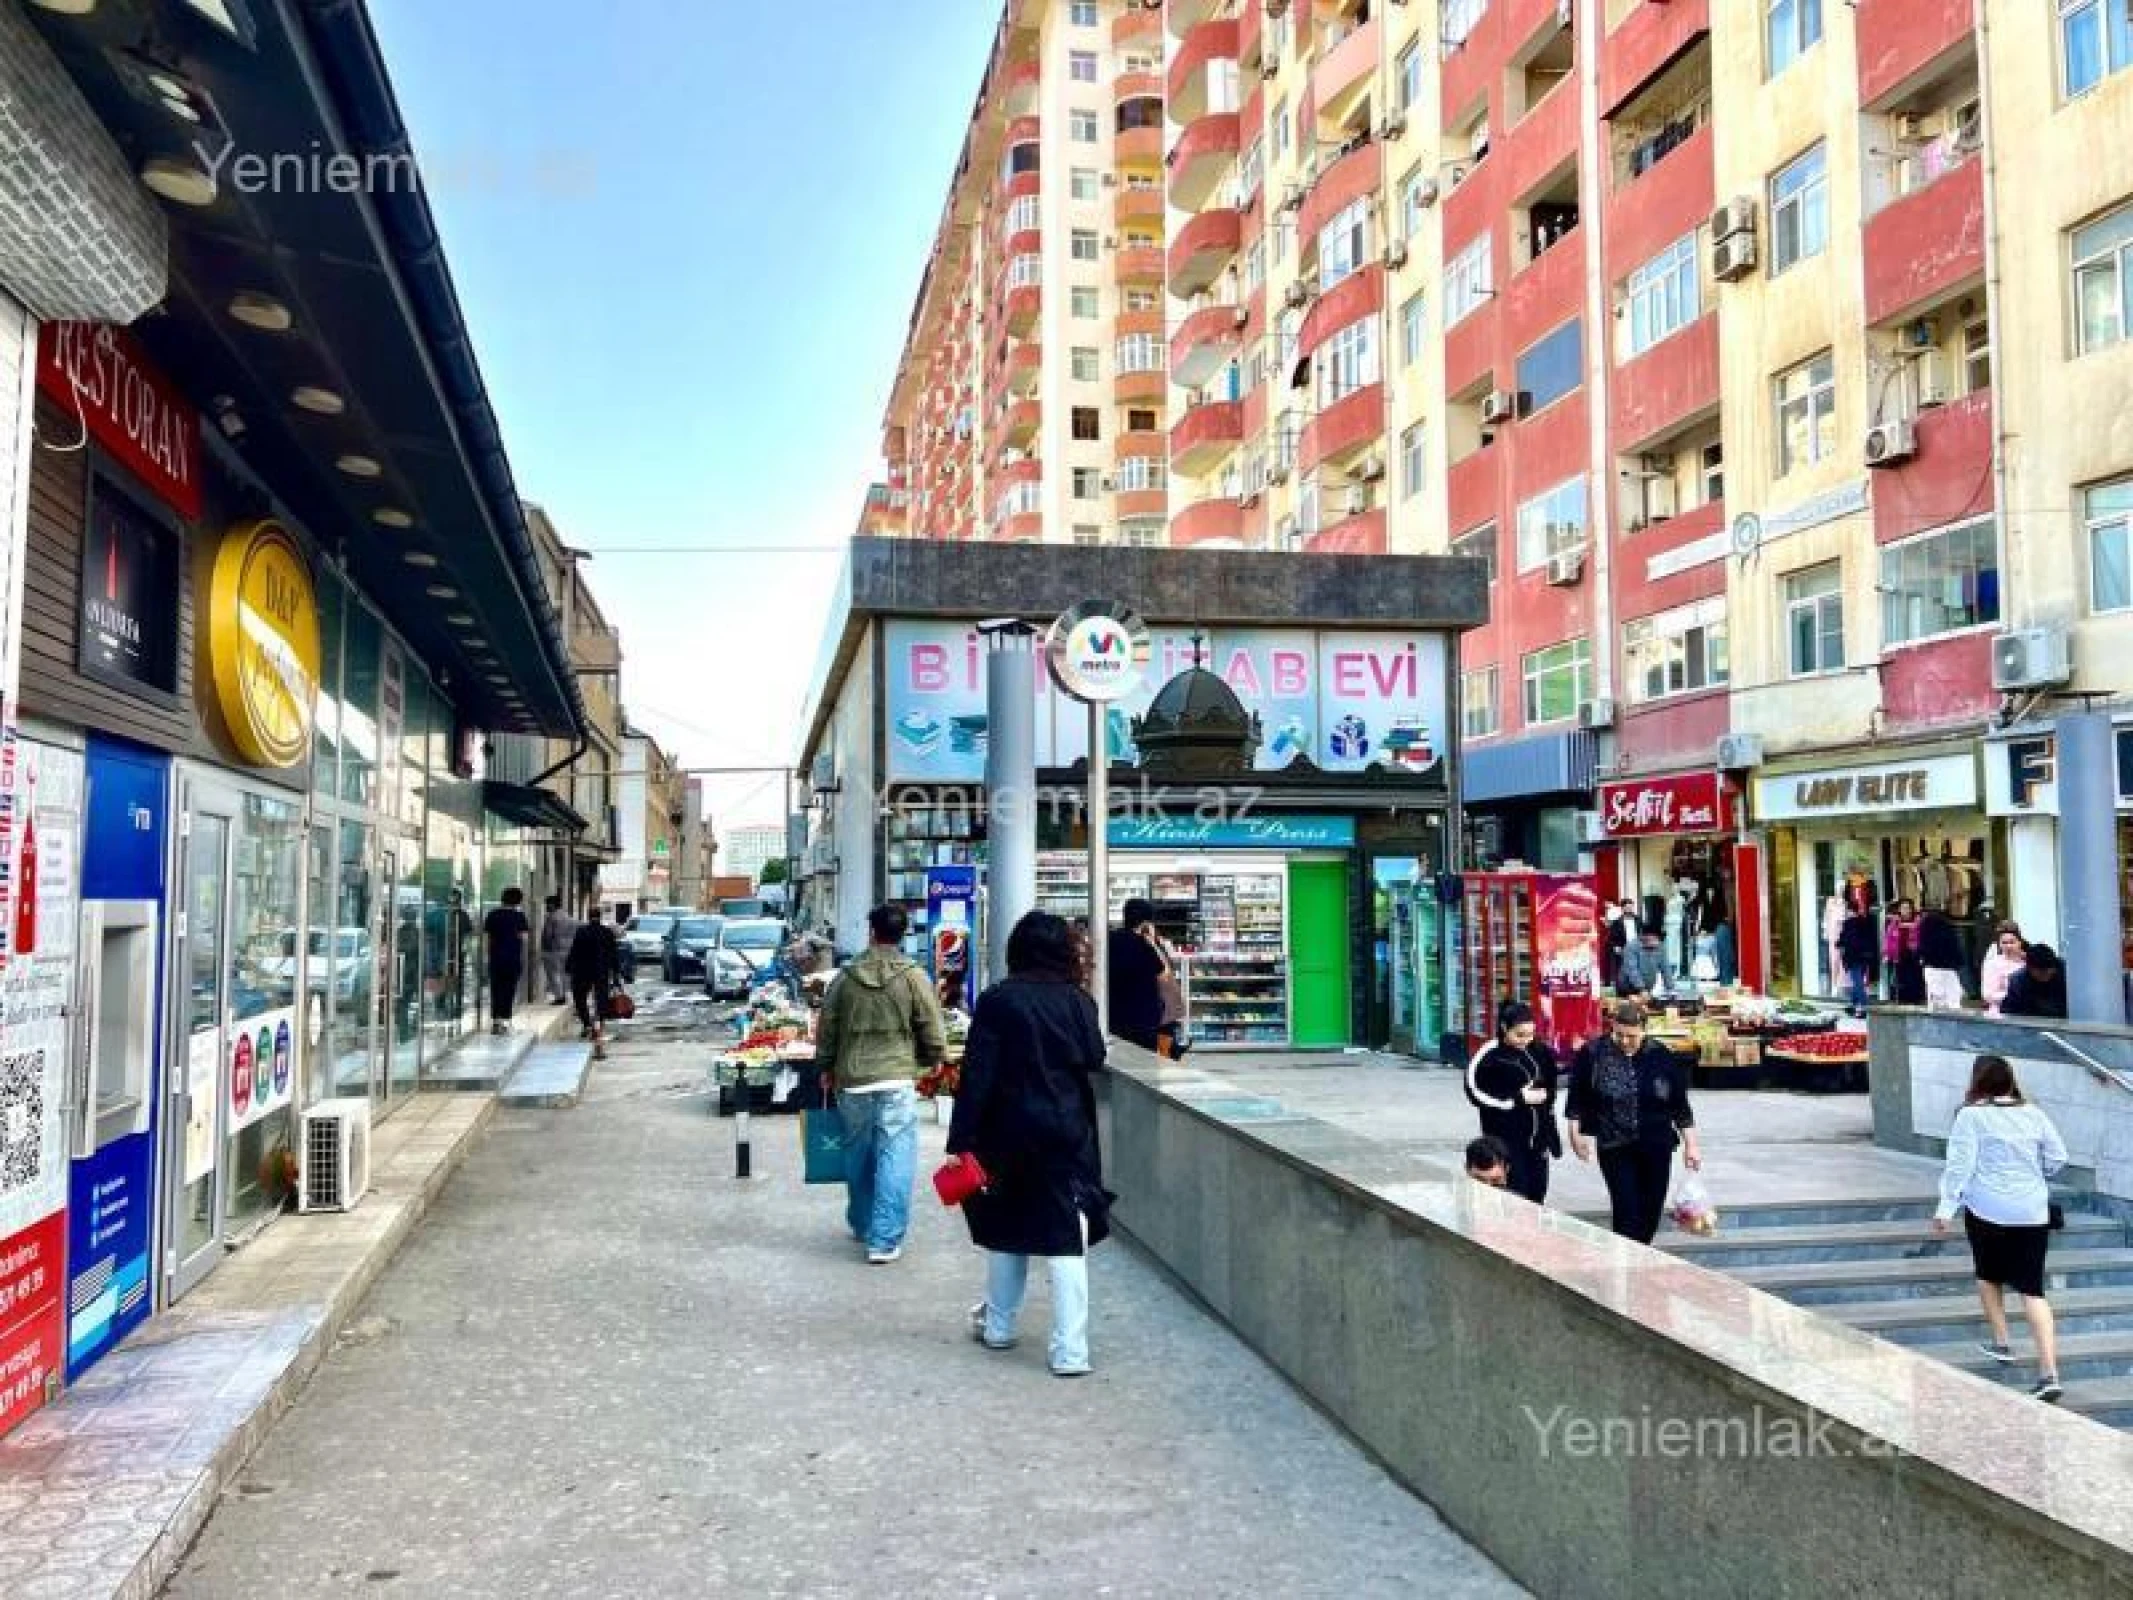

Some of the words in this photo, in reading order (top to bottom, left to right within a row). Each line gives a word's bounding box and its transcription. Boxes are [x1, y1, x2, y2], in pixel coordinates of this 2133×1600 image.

[53, 319, 188, 486] RESTORAN
[1333, 641, 1418, 699] EVİ
[1795, 777, 1854, 809] LADY
[1857, 769, 1930, 806] ELITE
